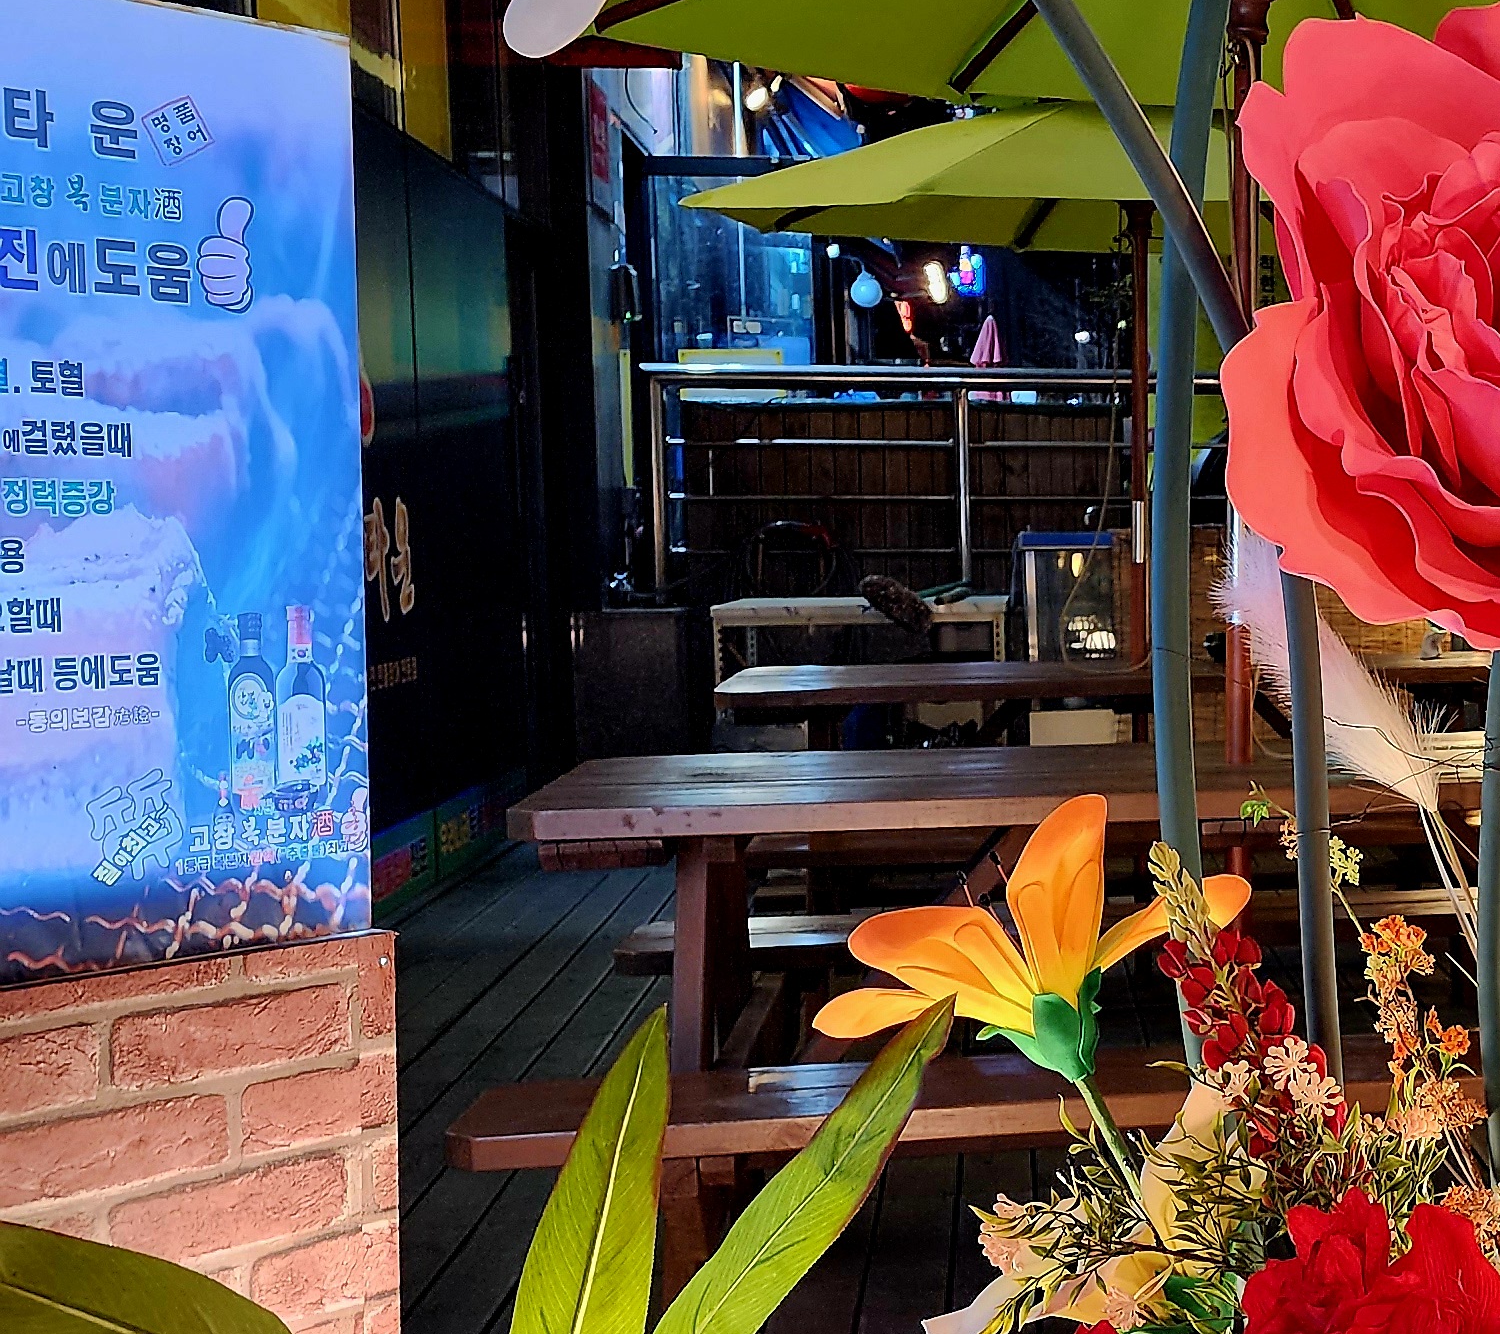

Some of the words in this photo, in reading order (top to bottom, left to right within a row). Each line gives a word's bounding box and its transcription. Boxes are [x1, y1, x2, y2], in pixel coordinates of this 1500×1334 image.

[30, 360, 84, 397] 토혈
[3, 479, 115, 516] 정력증강
[0, 597, 62, 633] 할때
[53, 653, 160, 691] 등에도움
